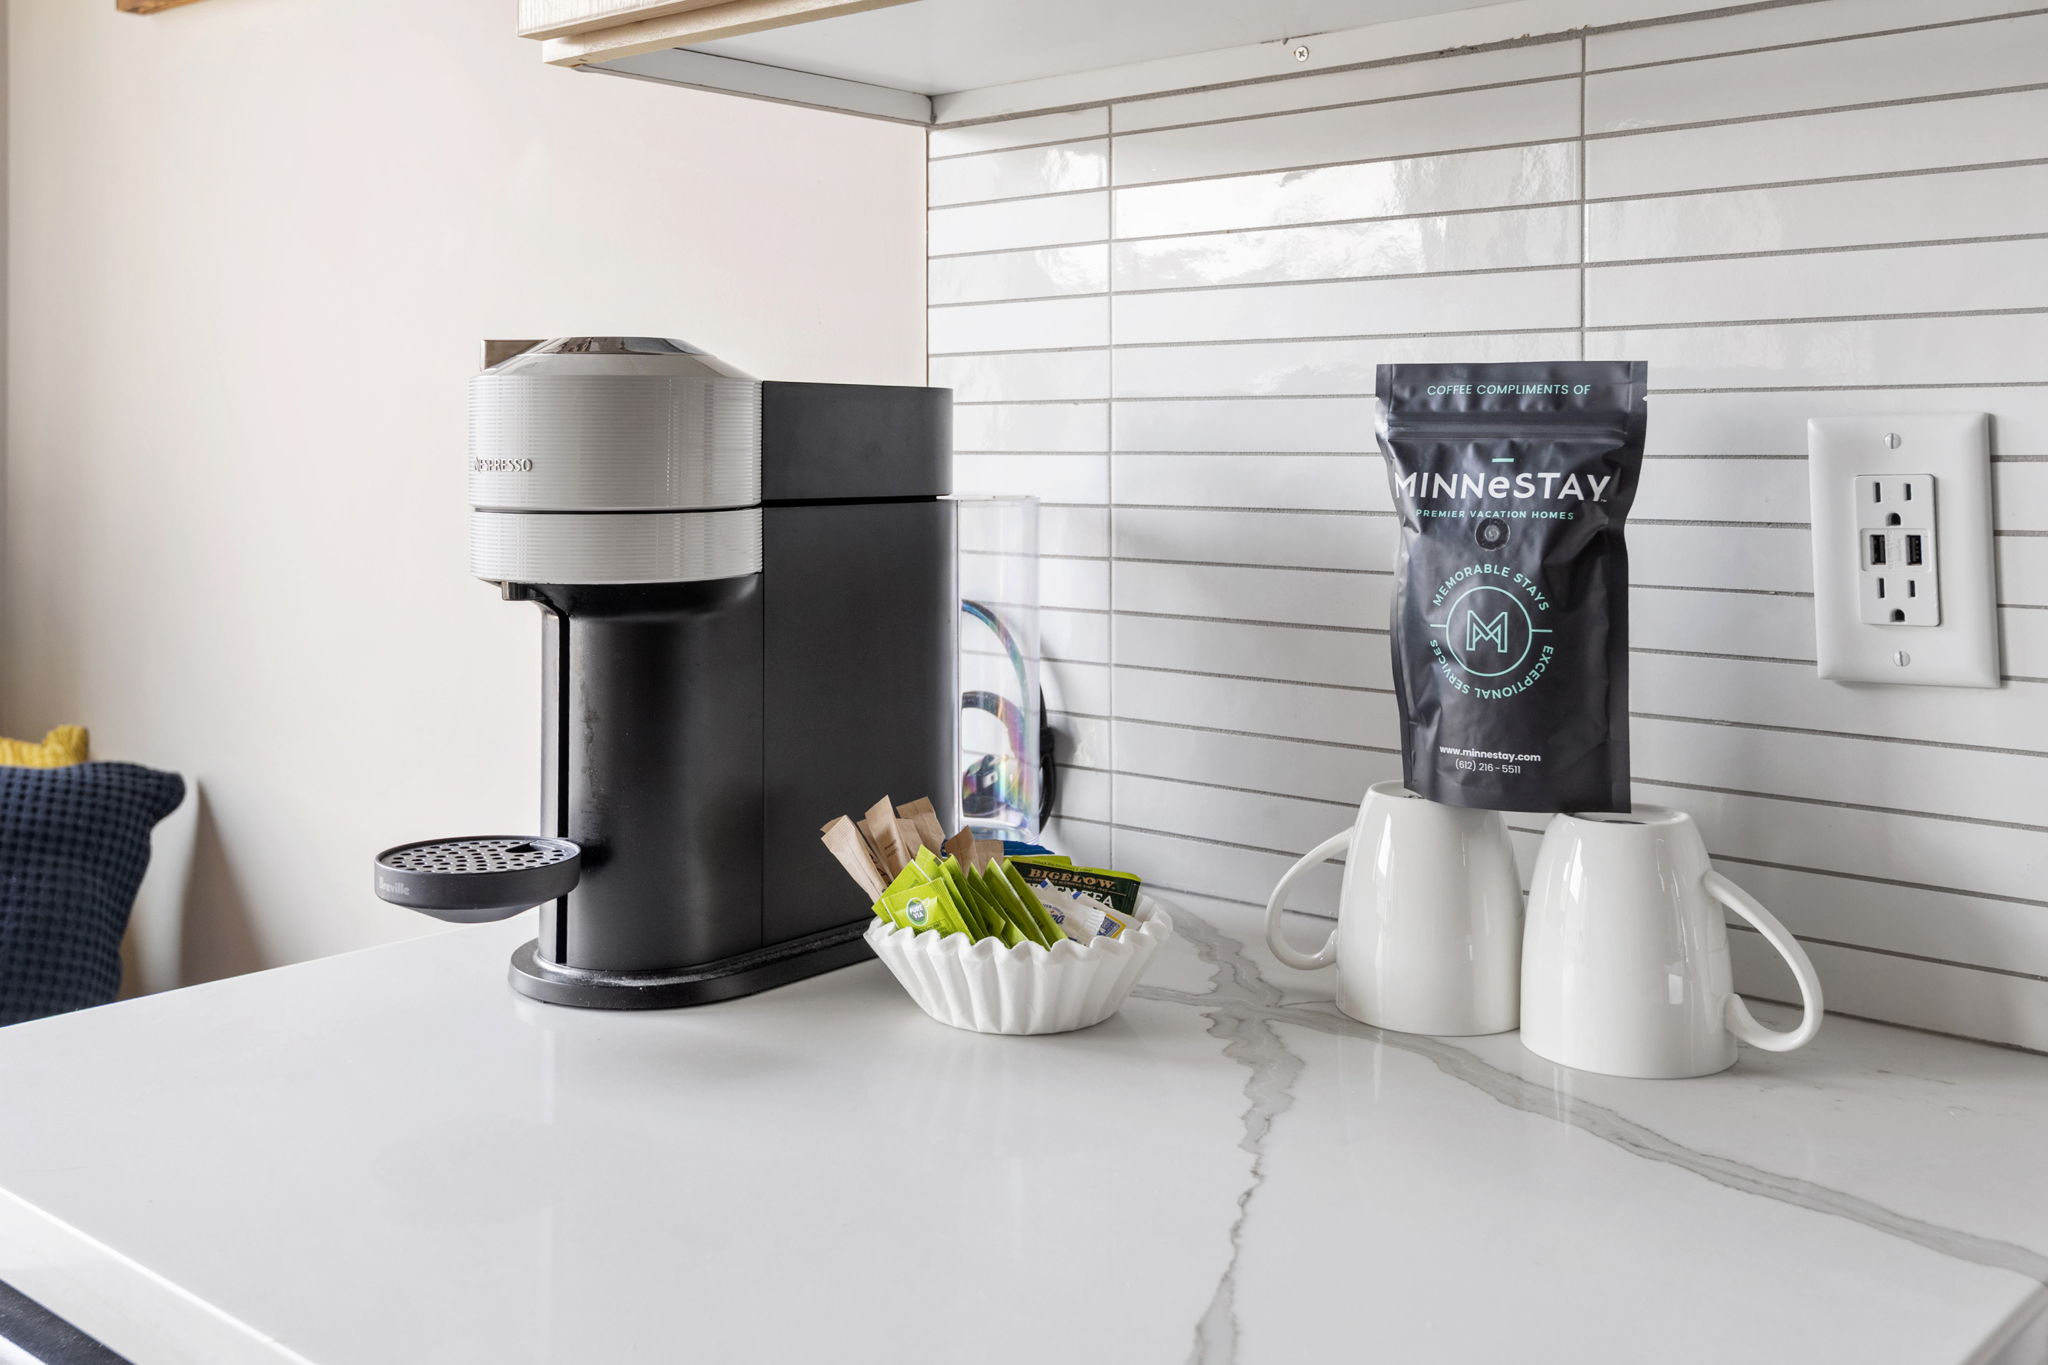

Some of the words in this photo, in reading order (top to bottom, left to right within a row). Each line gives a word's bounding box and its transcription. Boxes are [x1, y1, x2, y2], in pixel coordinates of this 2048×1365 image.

[1427, 384, 1473, 396] COFFEE
[1476, 384, 1569, 395] COMPLIMENTS
[1573, 384, 1591, 395] OF
[1415, 509, 1465, 518] PREMIER
[1469, 510, 1528, 518] VACATION
[1531, 511, 1574, 520] HOMES
[1432, 563, 1511, 607] MEMORABLE
[1513, 573, 1550, 611] STAYS
[1430, 639, 1471, 695] SERVICES
[1474, 645, 1554, 700] EXCEPTIONAL
[1439, 746, 1541, 762] www.minnestay.com
[1455, 758, 1476, 772] (612)
[1478, 762, 1494, 772] 216
[1501, 764, 1521, 774] 5511
[1029, 868, 1116, 889] BIGELOW
